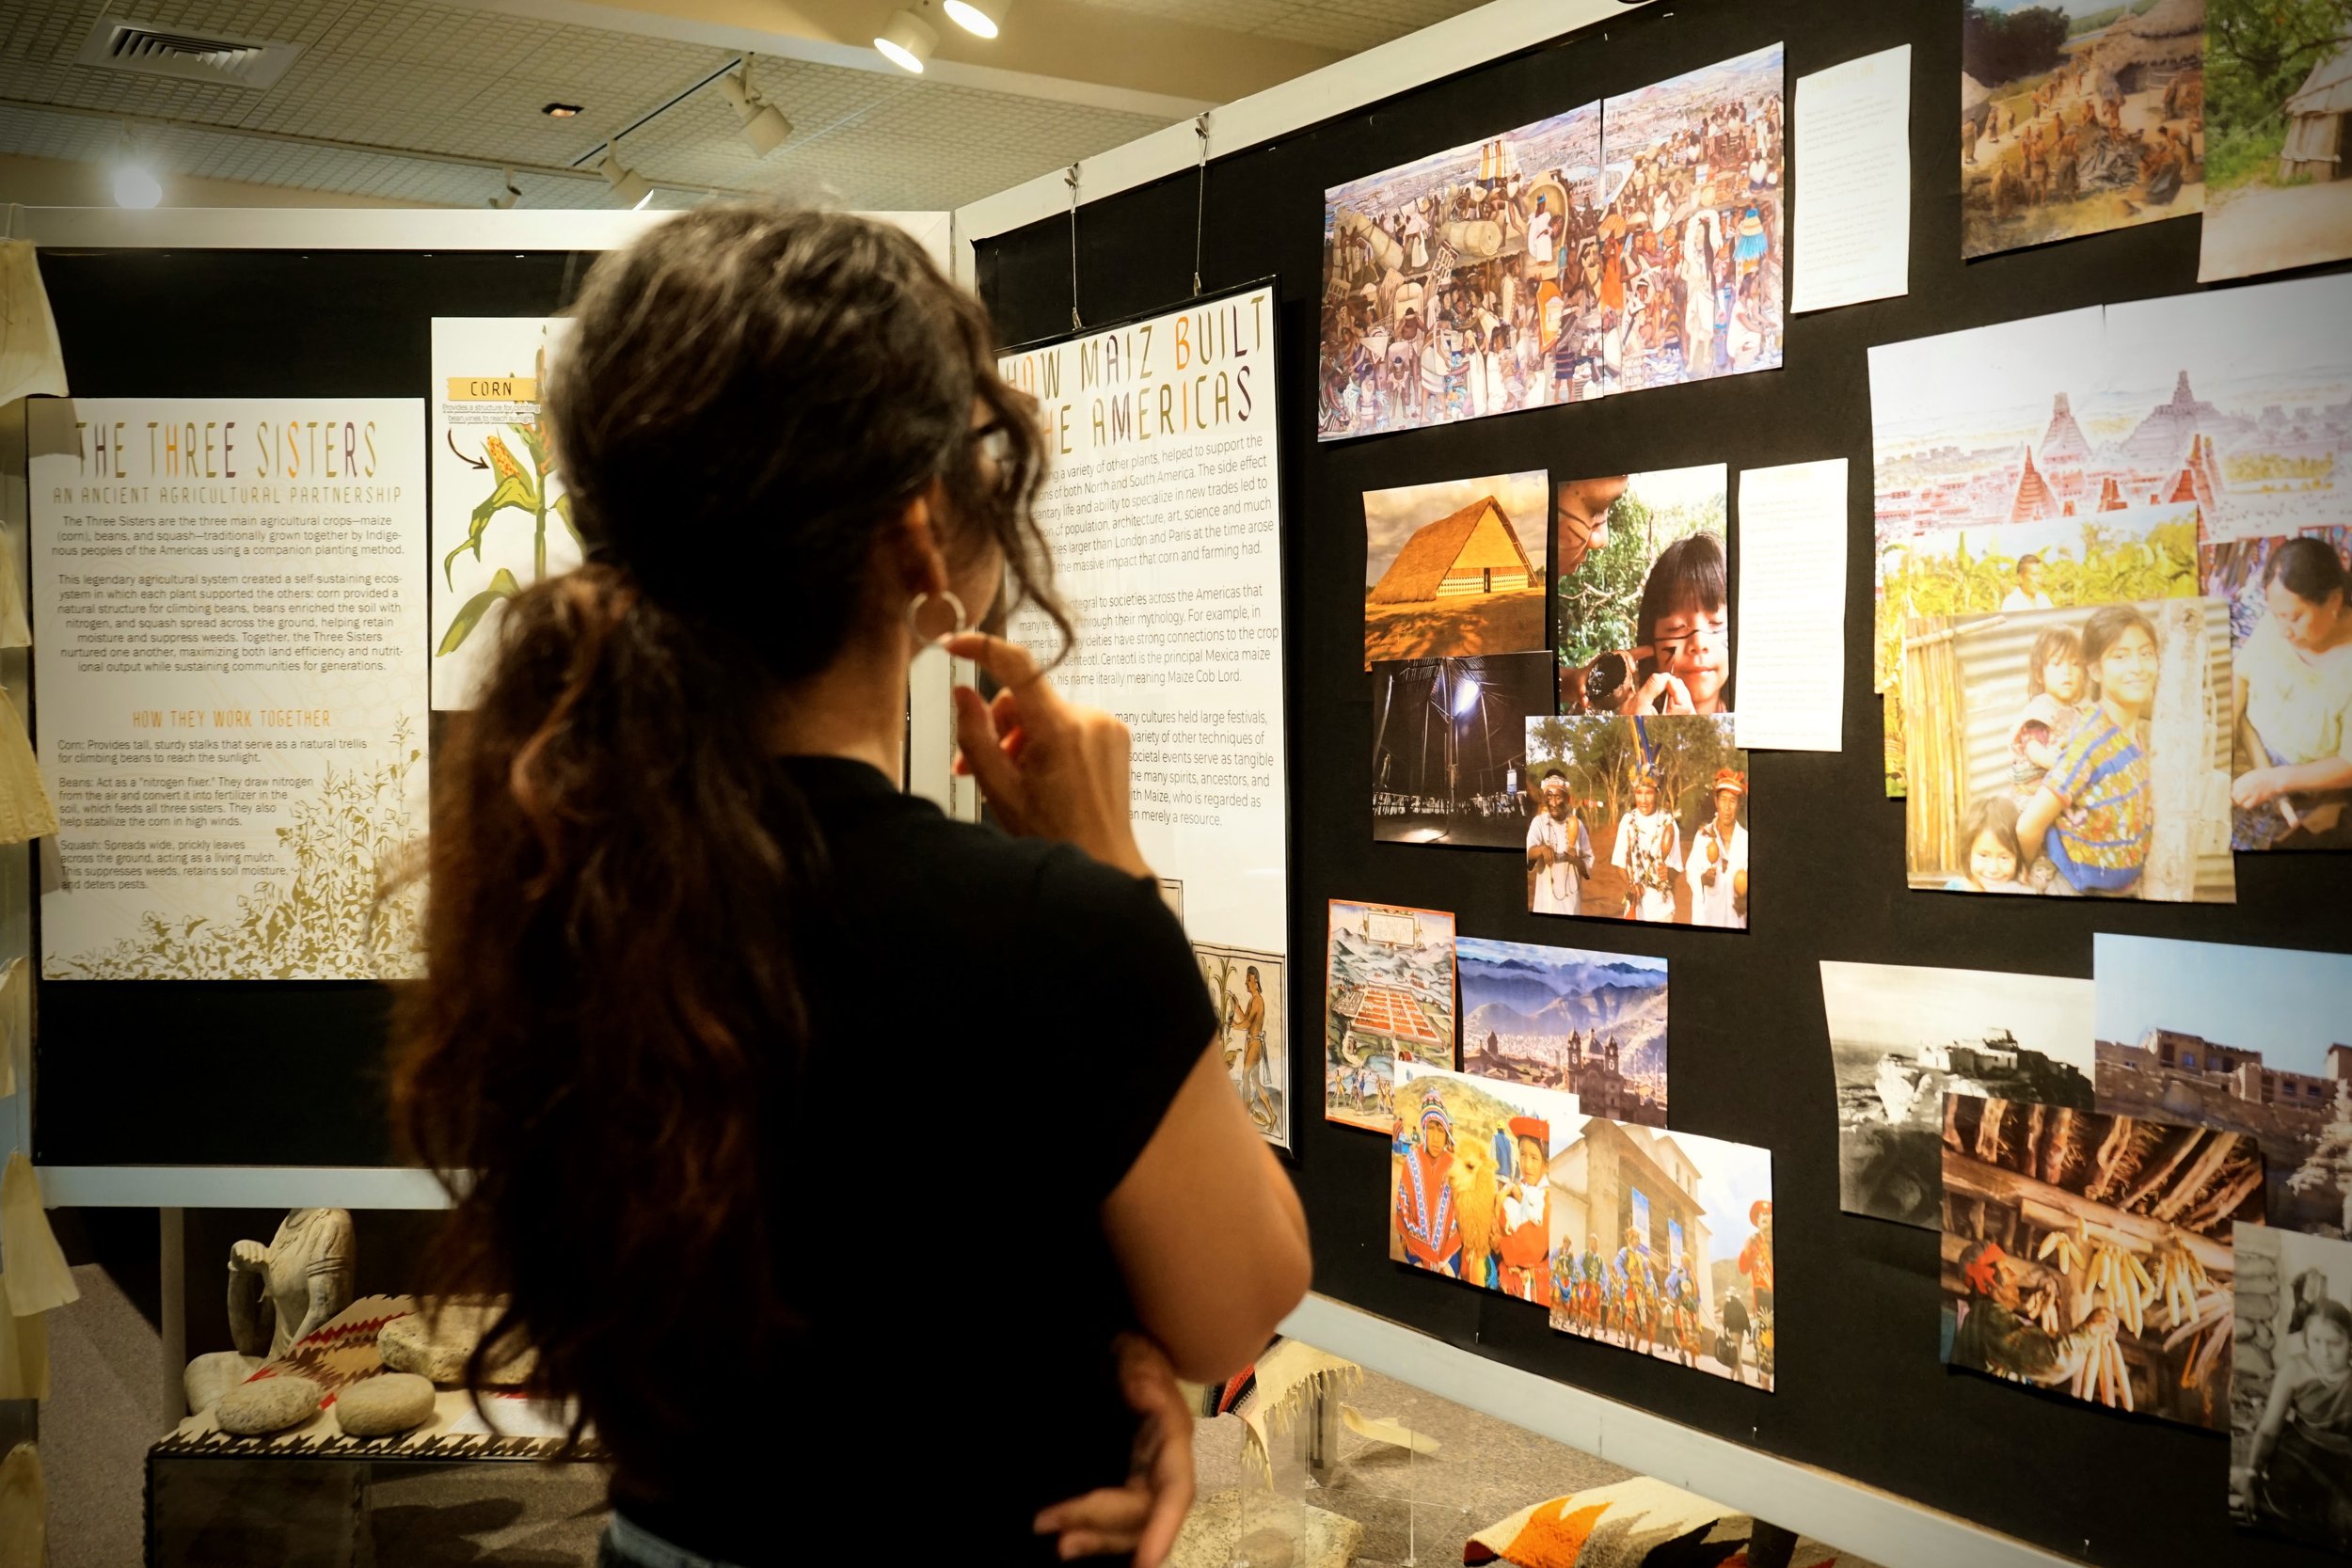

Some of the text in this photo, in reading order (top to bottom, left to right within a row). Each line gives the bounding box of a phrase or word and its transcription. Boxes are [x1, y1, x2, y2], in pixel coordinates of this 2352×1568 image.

[1007, 295, 1264, 400] HOW MAIZ BUILT
[470, 381, 512, 396] CORN
[1041, 365, 1252, 454] HE AMERICAS
[75, 421, 377, 479] THE THREE SISTERS
[1061, 469, 1065, 479] a
[1067, 464, 1094, 478] variety
[1097, 460, 1104, 473] of
[1106, 457, 1129, 472] other
[1161, 446, 1193, 463] helped
[1194, 445, 1204, 458] to
[1205, 437, 1245, 455] support
[1246, 436, 1263, 448] the
[1055, 485, 1062, 499] of
[1063, 483, 1082, 498] both
[1085, 481, 1108, 494] North
[1111, 476, 1127, 491] and
[1129, 472, 1155, 487] South
[1199, 463, 1216, 476] The
[1217, 459, 1238, 474] side
[1240, 455, 1267, 470] effect
[53, 487, 403, 503] AN ANCIENT AGRICULTURAL PARTNERSHIP
[63, 515, 83, 526] The
[85, 515, 117, 527] Three
[118, 515, 156, 527] Sisters
[157, 517, 176, 526] are
[178, 515, 197, 526] the
[199, 516, 228, 526] three
[230, 515, 257, 526] main
[260, 515, 320, 528] agricultural
[132, 531, 154, 541] and
[268, 531, 301, 543] grown
[303, 531, 349, 543] together
[350, 530, 363, 542] by
[51, 546, 78, 556] nous
[80, 546, 123, 557] peoples
[124, 545, 137, 555] of
[138, 546, 157, 555] the
[158, 545, 209, 555] Americas
[211, 545, 241, 558] using
[242, 546, 250, 555] a
[252, 545, 312, 556] companion
[314, 545, 359, 557] planting
[1058, 562, 1071, 573] the
[1073, 557, 1104, 571] massive
[1106, 555, 1136, 570] impact
[1138, 552, 1155, 565] that
[1158, 551, 1179, 563] corn
[1181, 546, 1200, 562] and
[1201, 546, 1239, 560] farming
[1099, 596, 1108, 608] to
[1108, 593, 1148, 607] societies
[1148, 592, 1176, 604] across
[1177, 589, 1194, 602] the
[1195, 587, 1241, 600] Americas
[1242, 585, 1263, 597] that
[1057, 673, 1069, 686] his
[1070, 674, 1094, 685] name
[1095, 672, 1125, 687] literally
[1126, 673, 1166, 687] meaning
[1168, 671, 1194, 683] Maize
[1195, 670, 1216, 683] Cob
[133, 709, 331, 728] HOW THEY WORK TOGETHER
[1114, 712, 1140, 726] many
[1140, 711, 1176, 723] cultures
[1177, 710, 1199, 723] held
[1200, 711, 1225, 726] large
[87, 739, 131, 750] Provides
[154, 739, 186, 752] sturdy
[188, 739, 219, 750] stalks
[221, 739, 243, 750] that
[245, 740, 273, 750] serve
[275, 740, 288, 750] as
[290, 740, 297, 749] a
[299, 739, 336, 749] natural
[339, 738, 367, 749] trellis
[1132, 731, 1264, 746] variety of other techniques of
[57, 752, 72, 764] for
[74, 752, 118, 765] climbing
[119, 753, 151, 763] beans
[153, 753, 165, 763] to
[167, 752, 196, 763] reach
[198, 752, 215, 763] the
[1129, 750, 1274, 768] societal events serve as tangible
[96, 777, 113, 787] Act
[114, 779, 128, 787] as
[129, 779, 136, 787] a
[217, 776, 243, 788] They
[244, 777, 269, 786] draw
[271, 777, 313, 789] nitrogen
[1144, 771, 1168, 785] many
[1250, 774, 1270, 787] and
[1172, 790, 1192, 803] who
[1195, 791, 1201, 805] is
[1204, 793, 1248, 808] regarded
[1249, 797, 1262, 808] as
[1142, 809, 1170, 825] merely
[1173, 813, 1178, 823] a
